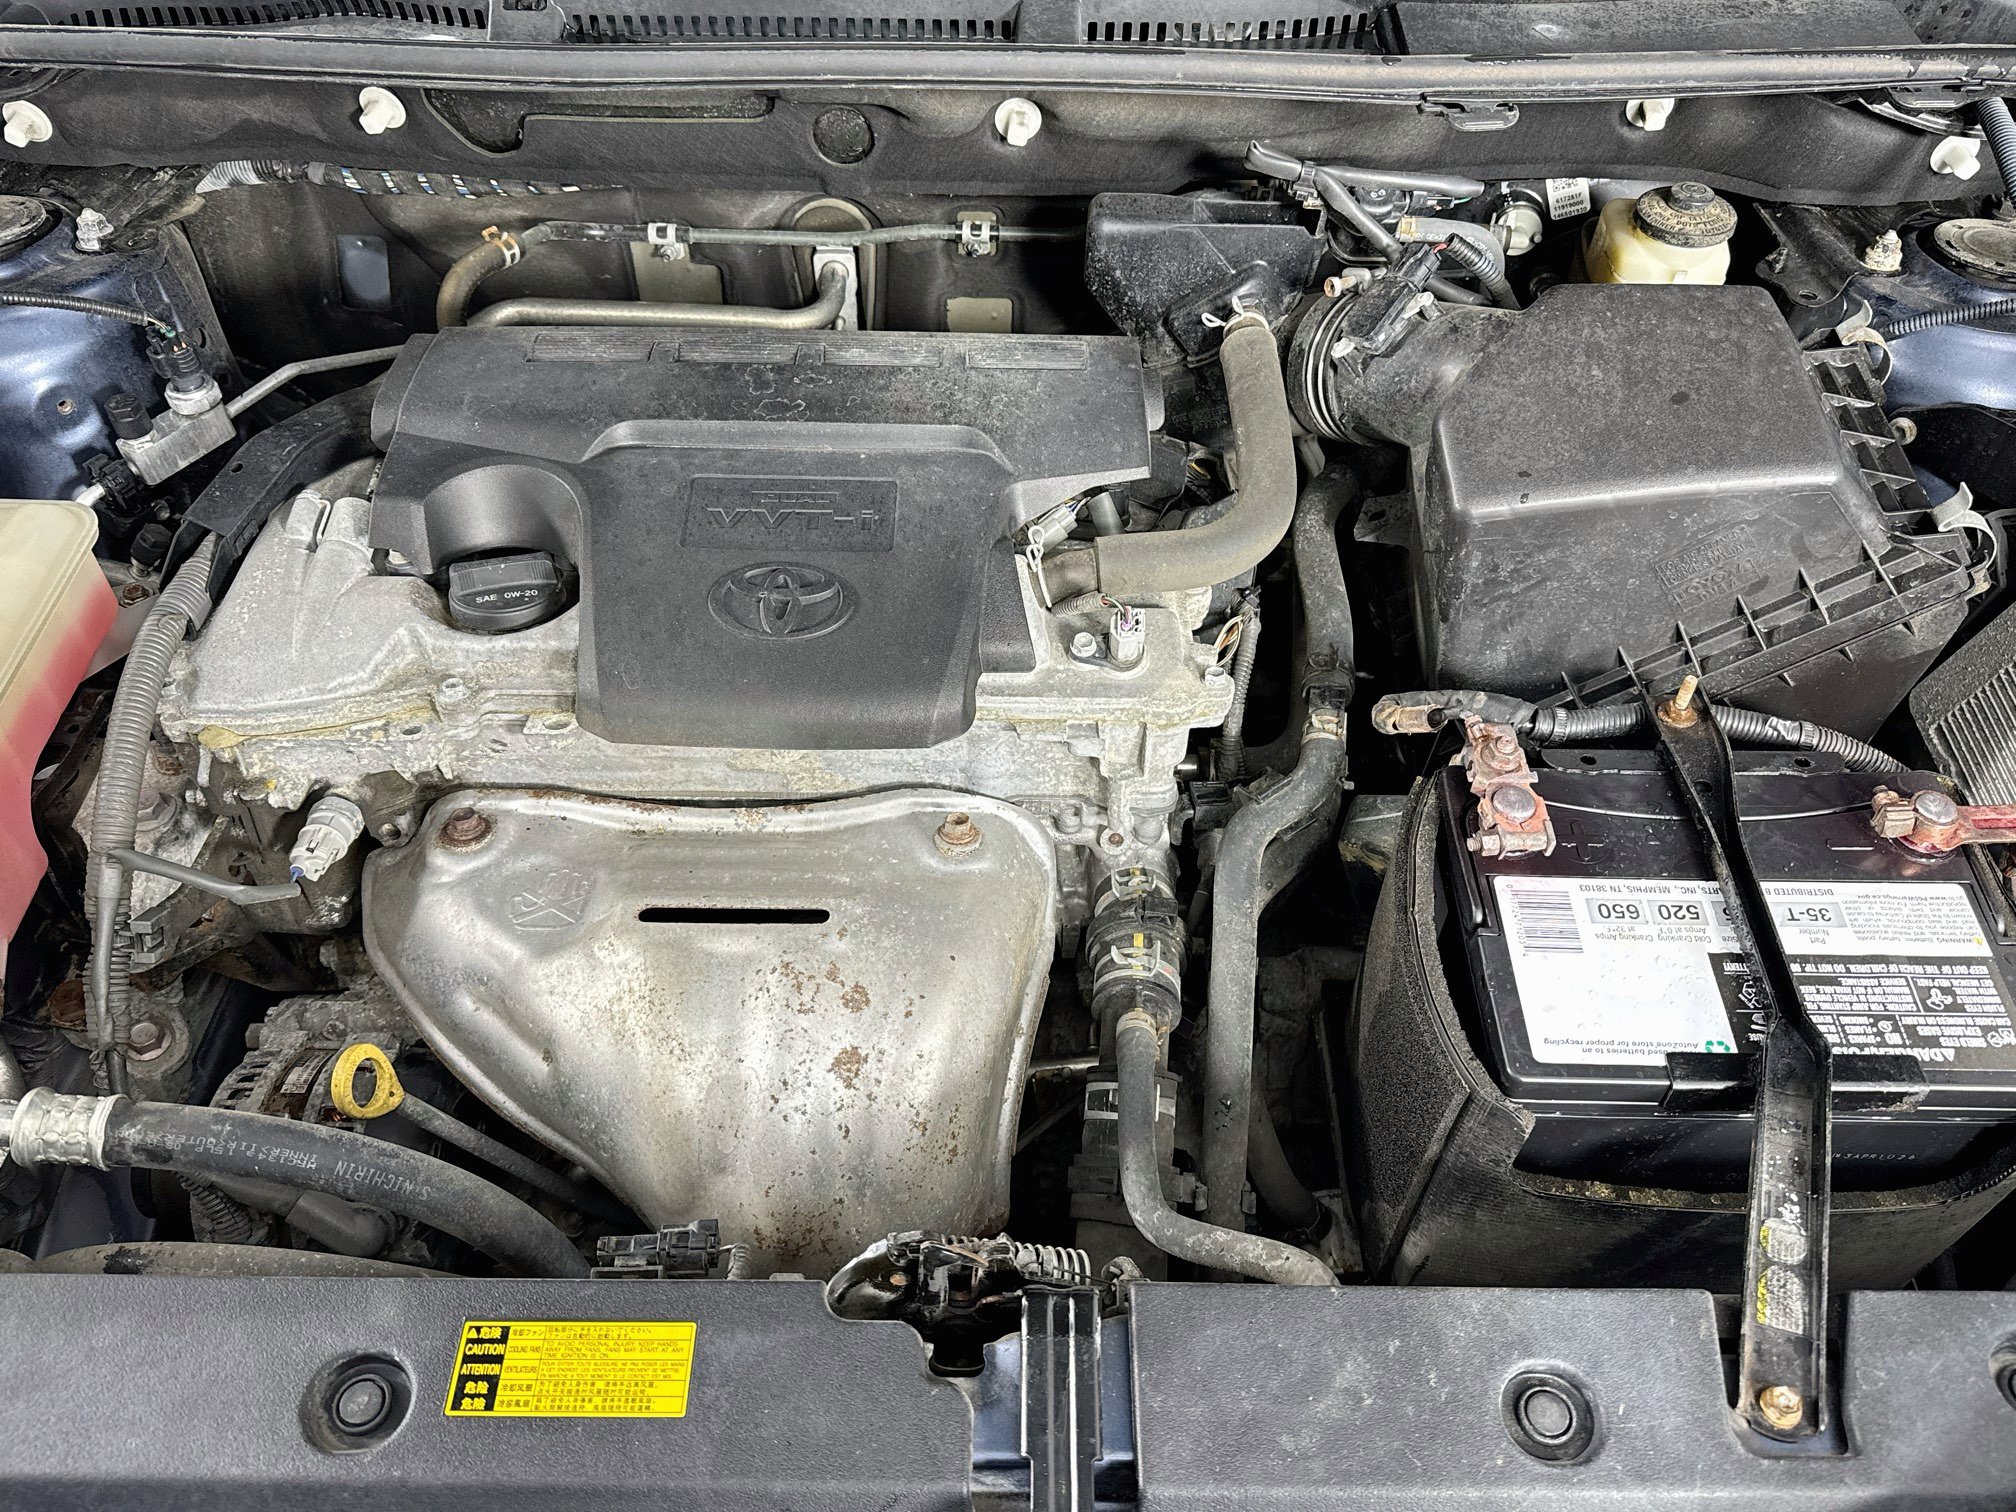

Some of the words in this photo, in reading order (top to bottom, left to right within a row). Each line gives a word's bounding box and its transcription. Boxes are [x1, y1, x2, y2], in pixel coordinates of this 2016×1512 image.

[706, 507, 874, 531] VVT-i
[475, 594, 498, 604] SAE
[1579, 884, 1607, 892] 38103
[1623, 884, 1671, 893] MEMPHIS,
[1773, 888, 1834, 896] DISTRIBUTED
[1597, 903, 1640, 920] 650
[1657, 904, 1701, 920] 520
[1787, 907, 1832, 922] 35-T
[1685, 926, 1706, 934] Amps
[1799, 928, 1830, 936] Number
[1594, 933, 1617, 941] Amps
[1619, 933, 1654, 942] Cranking
[1657, 934, 1692, 943] Cranking
[1694, 935, 1712, 943] Cold
[1809, 937, 1827, 945] Part
[1543, 1038, 1584, 1046] recycling
[1884, 1032, 1903, 1045] NO
[1585, 1039, 1615, 1047] proper
[1616, 1040, 1630, 1048] for
[1631, 1040, 1654, 1048] store
[1606, 1048, 1645, 1056] batteries
[334, 1160, 416, 1195] NICHIRIN
[465, 1343, 506, 1355] CAUTION
[460, 1363, 502, 1376] ATTENTION
